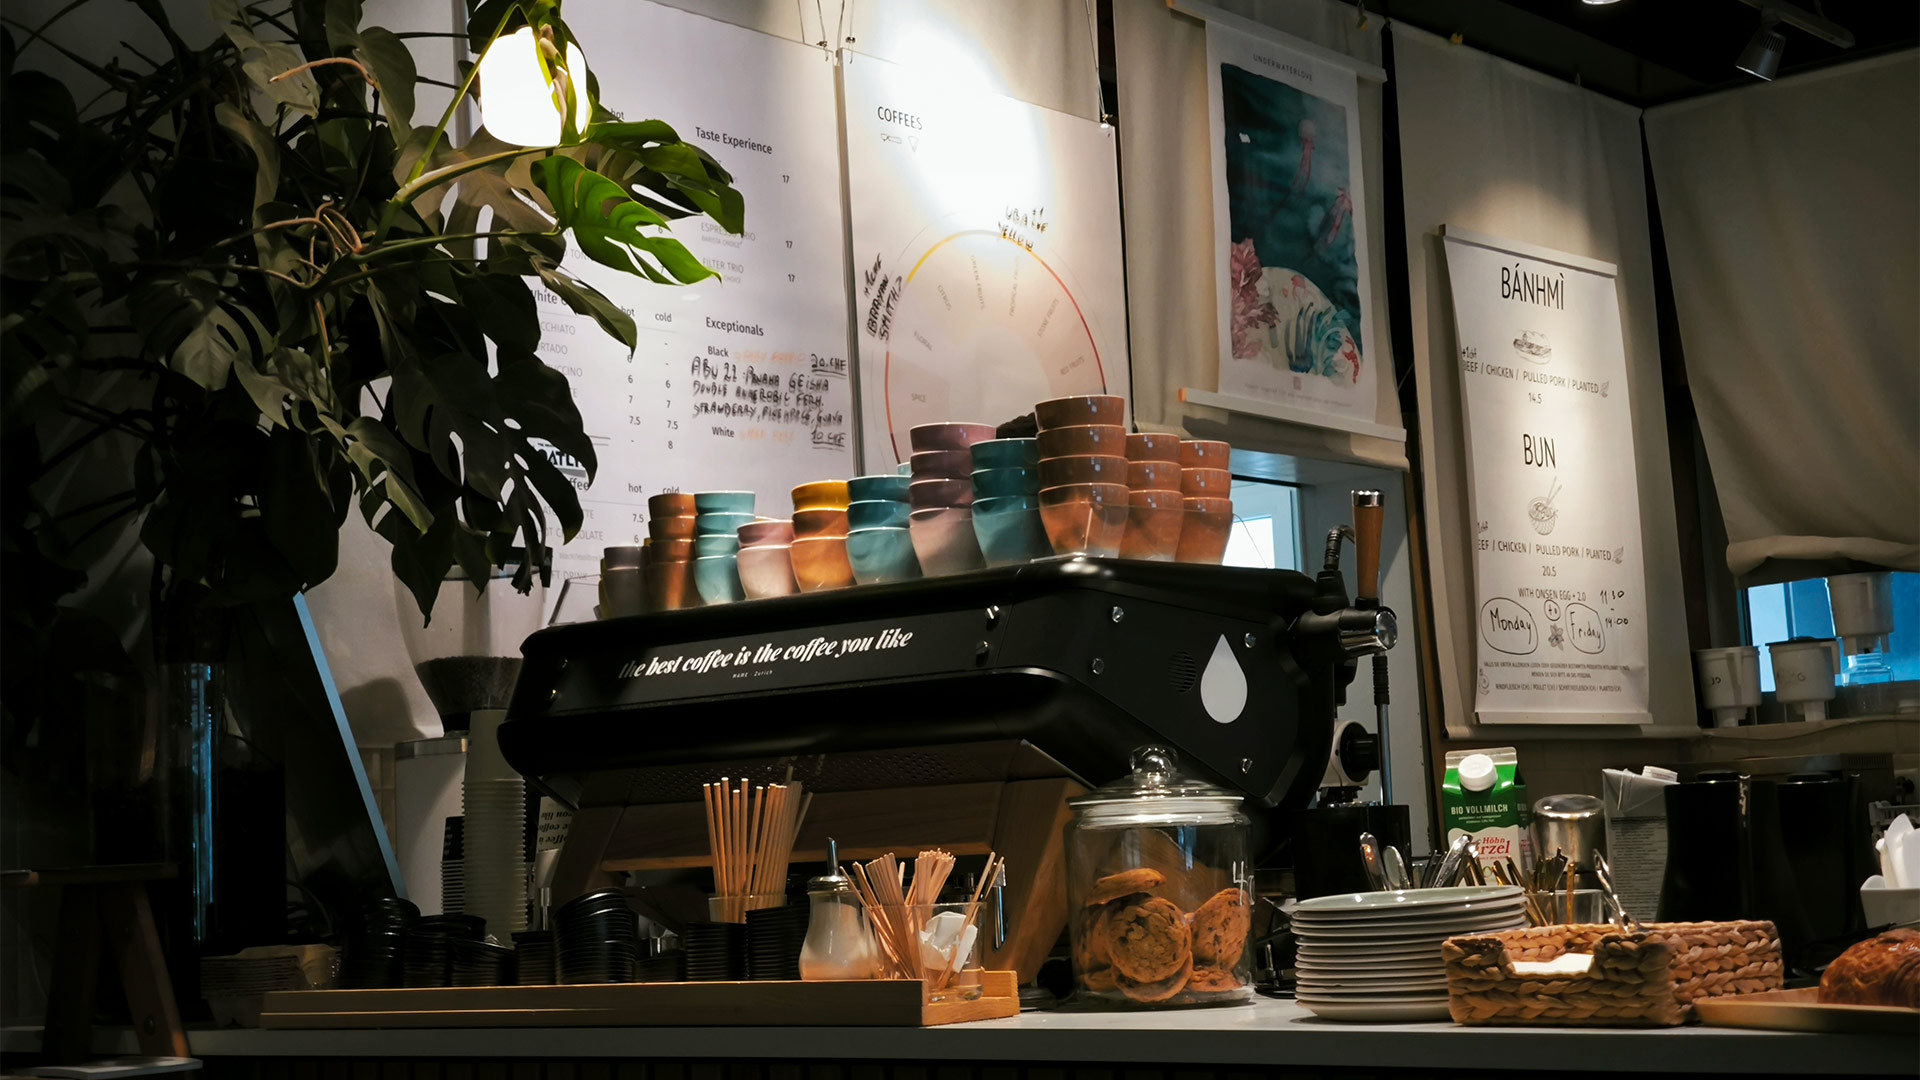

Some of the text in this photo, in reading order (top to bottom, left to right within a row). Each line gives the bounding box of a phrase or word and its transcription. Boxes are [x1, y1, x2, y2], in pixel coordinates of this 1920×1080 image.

[1253, 54, 1313, 82] UNDERWATERLOVE
[878, 106, 923, 131] COFFEES
[696, 126, 773, 155] Taste Experience
[782, 175, 790, 184] 17
[785, 240, 793, 249] 17
[727, 262, 745, 274] TRIO
[788, 274, 796, 283] 17
[1501, 263, 1565, 310] BÁNHMÌ
[655, 311, 673, 324] cold
[540, 321, 576, 336] CCHIATO
[706, 316, 765, 337] Exceptionals
[540, 342, 568, 355] RTADO
[708, 345, 730, 358] Black
[628, 374, 672, 389] 6 6
[1486, 363, 1514, 379] CHICKEN
[1523, 370, 1548, 385] PULLED
[1549, 375, 1567, 388] PORK
[1572, 379, 1599, 394] PLANTED
[628, 395, 672, 408] 7 7
[1528, 392, 1543, 405] 14.5
[630, 416, 679, 430] 7.5 7.5
[711, 426, 735, 438] White
[668, 440, 674, 450] 8
[1523, 433, 1556, 469] BUN
[628, 482, 680, 495] hot cold
[632, 513, 645, 524] 7.5
[634, 535, 640, 544] 6
[1478, 539, 1489, 551] EEF
[1497, 540, 1527, 553] CHICKEN
[1536, 544, 1561, 556] PULLED
[1562, 546, 1579, 558] PORK
[1586, 548, 1612, 561] PLANTED
[1542, 565, 1557, 577] 20.5
[1518, 587, 1534, 598] WITH
[1535, 588, 1559, 600] ONSEN
[1559, 590, 1571, 601] EGG
[1577, 591, 1587, 602] 2.0
[1548, 604, 1558, 615] to
[1490, 608, 1533, 645] Monday
[1570, 611, 1602, 650] Friday
[618, 627, 914, 679] the best coffee is the coffee you like
[1450, 806, 1464, 815] BIO
[1465, 803, 1508, 814] VOLLMILCH
[1482, 836, 1506, 845] Höhn
